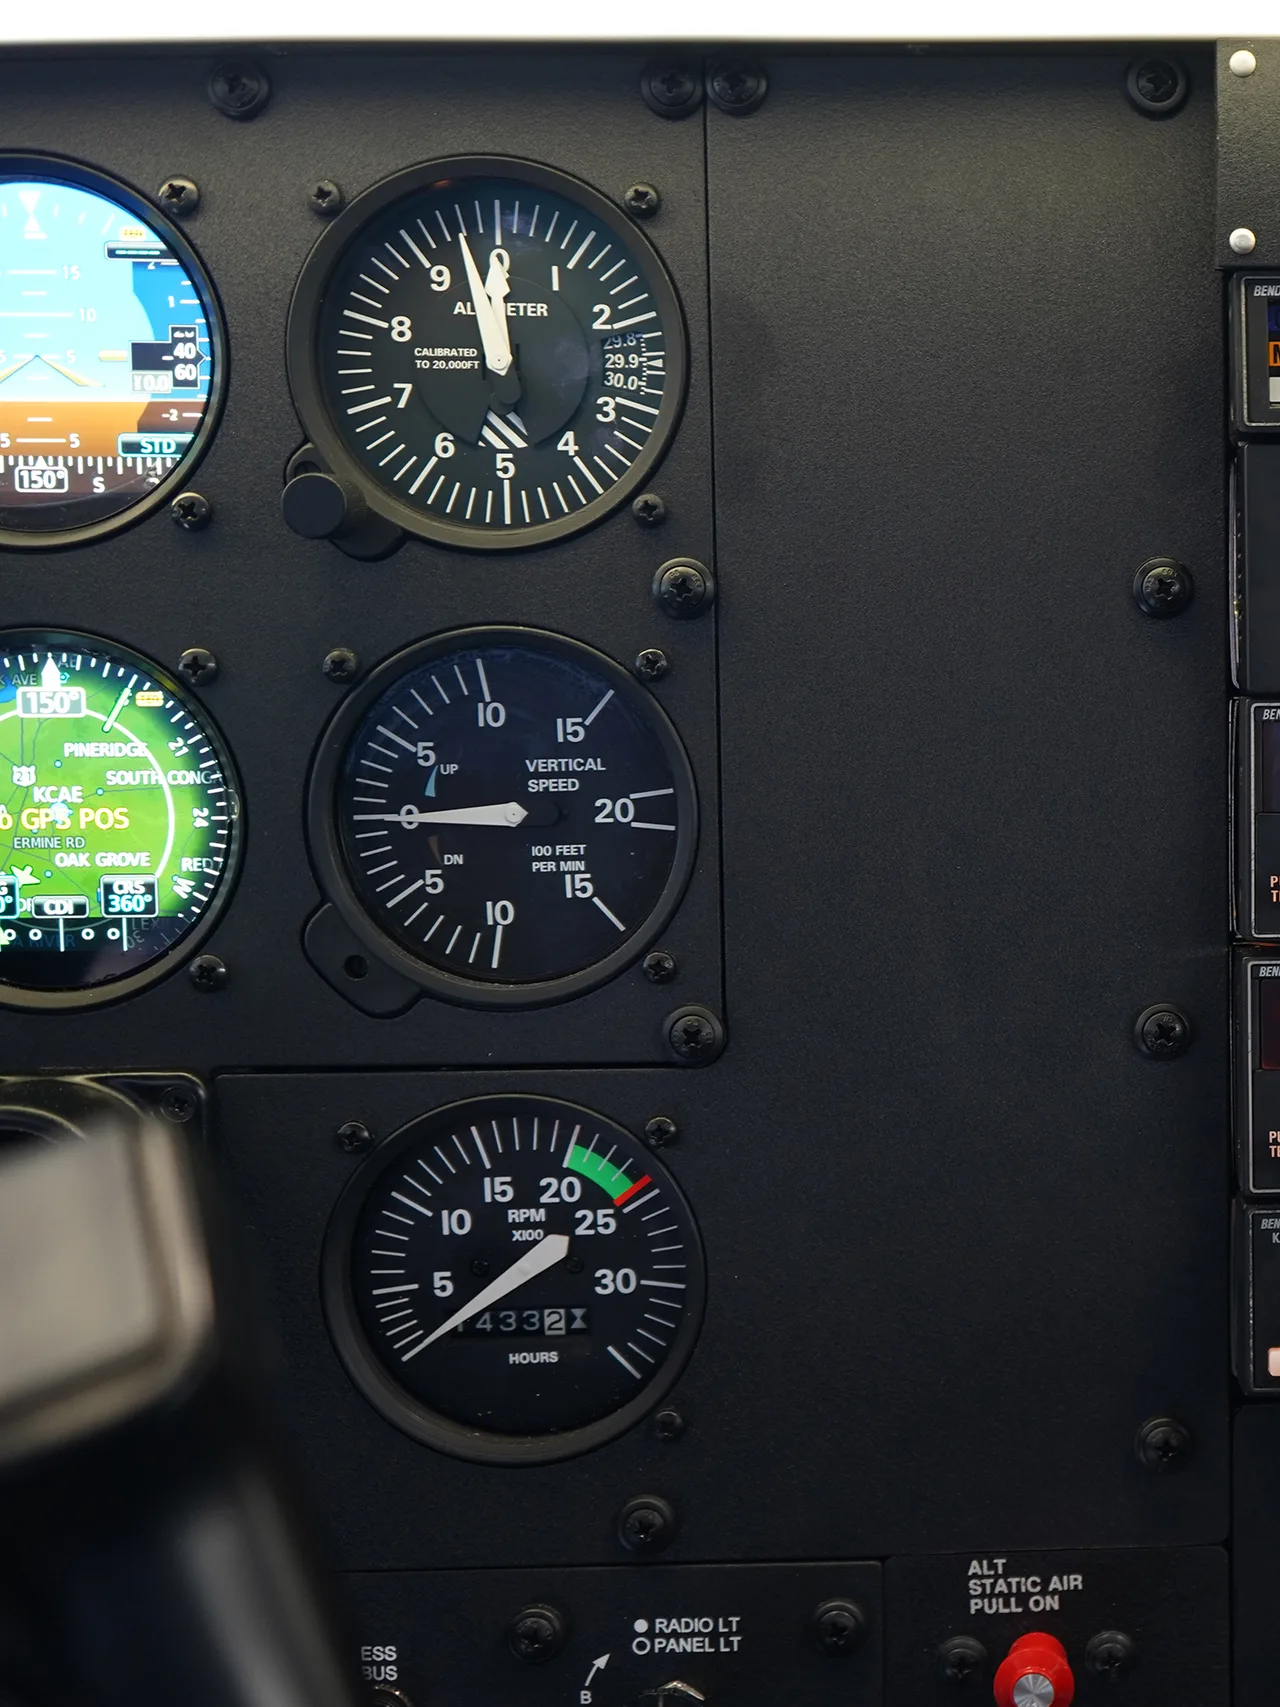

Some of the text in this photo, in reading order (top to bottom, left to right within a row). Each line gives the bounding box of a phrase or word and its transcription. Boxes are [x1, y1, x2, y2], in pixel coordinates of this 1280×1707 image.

[453, 302, 549, 317] ALETER
[414, 348, 477, 357] CALIBRATED
[415, 360, 480, 370] TO 20,000FT
[604, 354, 639, 369] 29.9
[604, 372, 638, 391] 30.0
[140, 437, 176, 455] STD
[64, 742, 149, 757] PINERIDGE
[440, 763, 459, 775] UP
[525, 758, 606, 772] VERTICAL
[106, 771, 164, 785] SOUTH
[527, 778, 579, 792] SPEED
[33, 786, 83, 803] KCAE
[594, 798, 634, 823] 20
[22, 807, 130, 830] GPS POS
[14, 837, 85, 849] ERMINE RD
[555, 844, 586, 857] FEET
[55, 852, 151, 867] OAK GROVE
[443, 854, 464, 865] DN
[532, 860, 585, 872] PER MIN
[113, 881, 145, 894] CRS
[44, 900, 74, 914] CDI
[539, 1176, 581, 1203] 20
[507, 1209, 546, 1223] RPM
[574, 1209, 617, 1235] 25
[594, 1269, 637, 1295] 30
[509, 1352, 559, 1365] HOURS
[967, 1558, 1007, 1576] ALT
[968, 1575, 1084, 1596] STATIC AIR
[969, 1595, 1060, 1614] PULL ON
[655, 1617, 740, 1633] RADIO LT
[654, 1636, 742, 1654] PANEL LT
[361, 1646, 397, 1661] ESS
[362, 1666, 398, 1681] BUS
